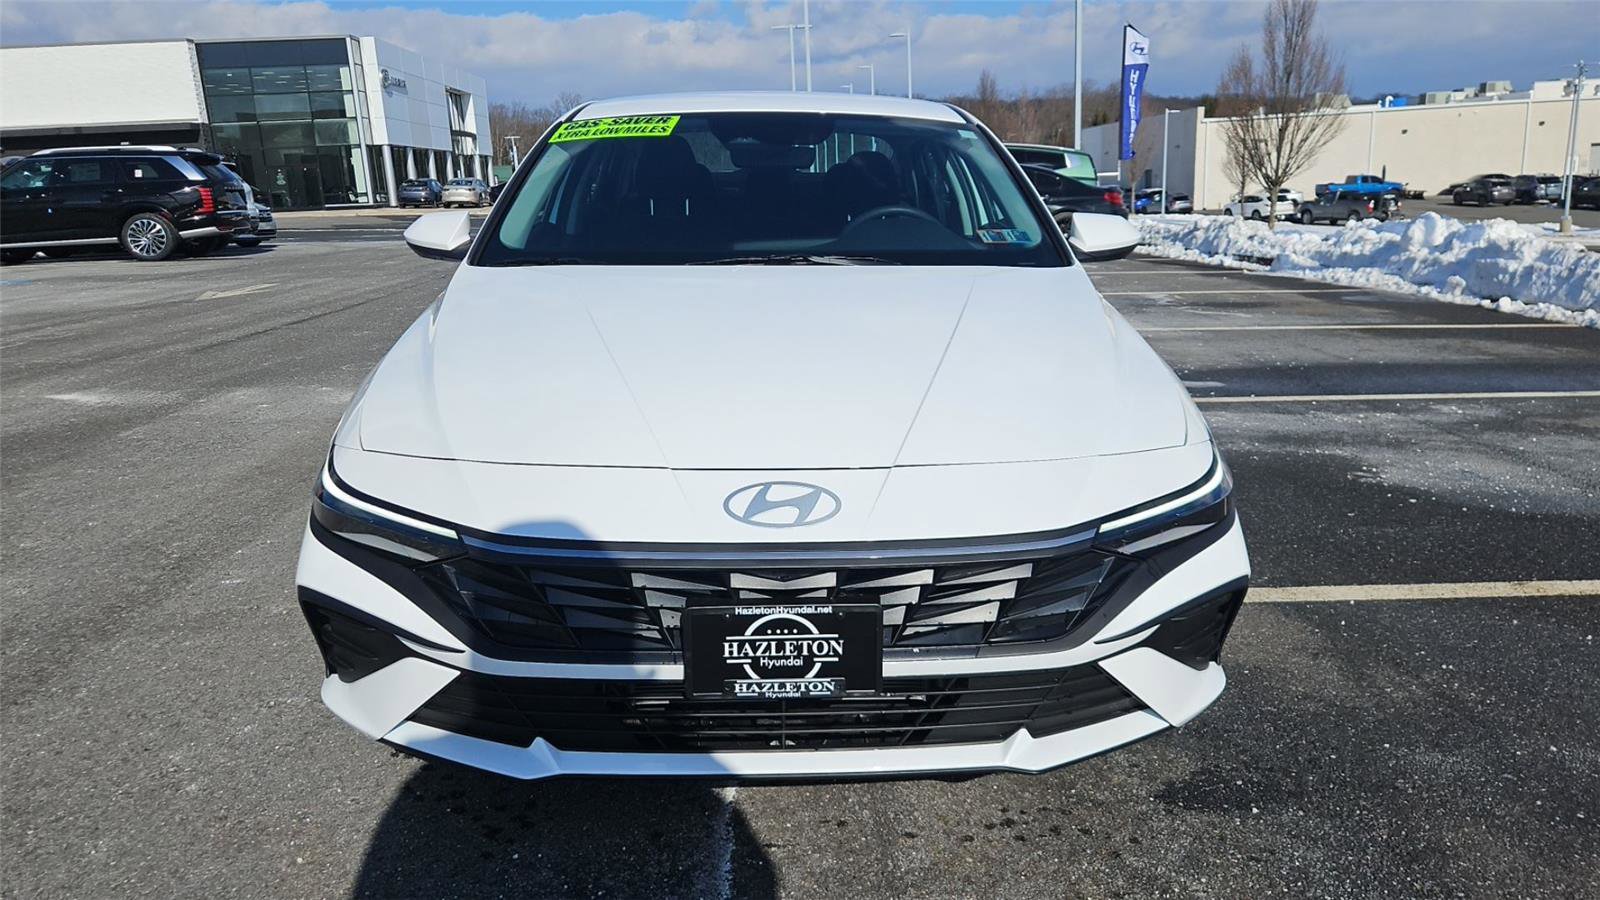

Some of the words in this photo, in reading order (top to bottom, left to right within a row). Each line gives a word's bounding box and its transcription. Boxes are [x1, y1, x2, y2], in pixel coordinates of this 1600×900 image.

[1129, 68, 1140, 158] HYUND
[735, 606, 833, 616] HazletonHyundai.net
[722, 639, 845, 658] HAZLETON
[760, 656, 804, 669] Hyundai
[734, 681, 836, 693] HAZLETON
